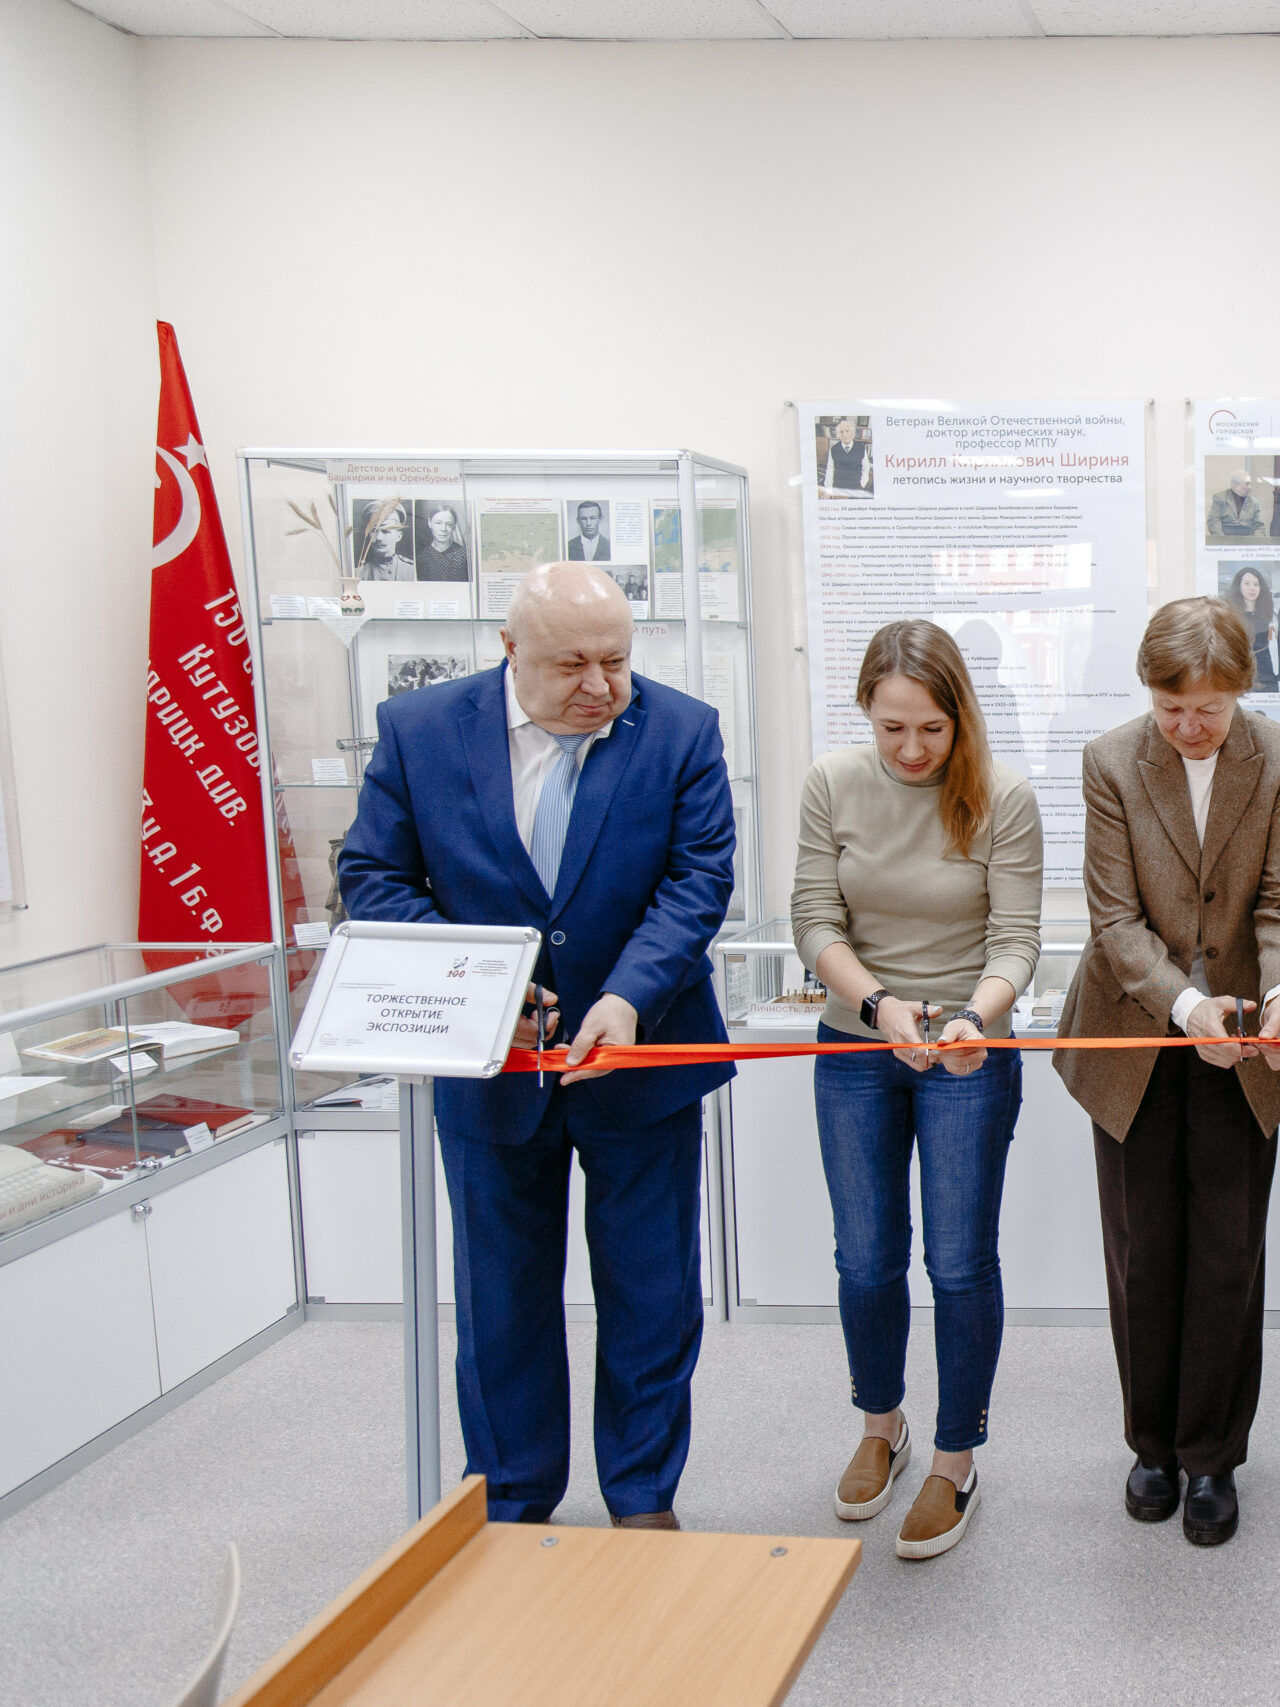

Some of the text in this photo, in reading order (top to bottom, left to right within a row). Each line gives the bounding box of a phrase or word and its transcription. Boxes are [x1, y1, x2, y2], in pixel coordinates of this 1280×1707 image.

[886, 415, 1126, 428] Ветеран Великой Отечественной войны,
[926, 428, 1086, 439] доктор исторических наук,
[955, 438, 1057, 450] профессор МГПУ
[885, 452, 1129, 471] Кирилл Крович Шириня
[346, 464, 385, 473] Детство
[328, 473, 375, 483] Башкирии
[400, 474, 459, 483] Оренбуржье
[892, 475, 1122, 486] летопись жизни и научного творчества
[642, 626, 666, 636] путь
[366, 994, 468, 1007] ТОРЖЕСТВЕННОЕ
[750, 1004, 801, 1013] Личность,
[381, 1009, 443, 1020] ОТКРЫТИЕ
[366, 1022, 449, 1034] ЭКСПОЗИЦИИ
[18, 1197, 37, 1212] дни
[40, 1176, 85, 1201] историка
